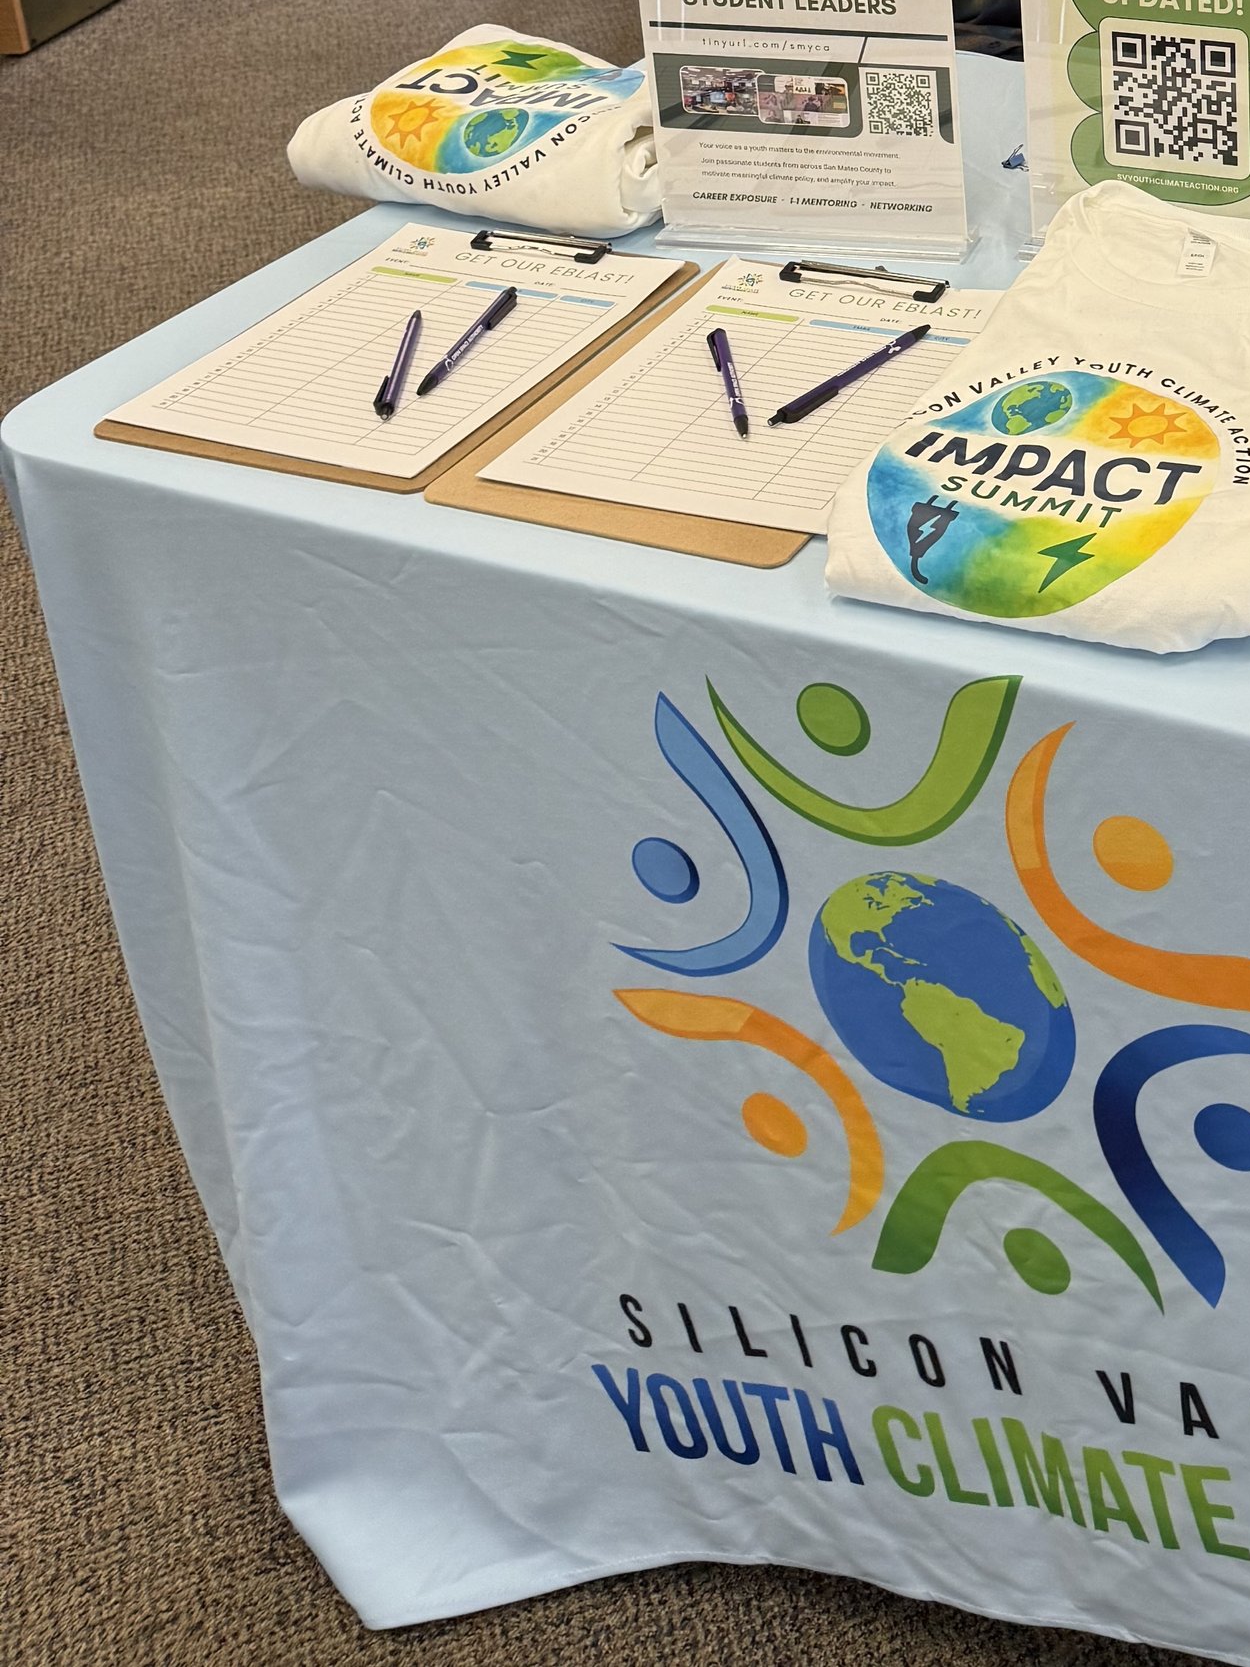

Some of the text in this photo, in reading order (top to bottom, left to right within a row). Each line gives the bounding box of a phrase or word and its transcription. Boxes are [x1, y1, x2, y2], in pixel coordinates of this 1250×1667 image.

[702, 38, 830, 52] tinyurl.com/smyca
[396, 69, 608, 109] IMPACT
[355, 129, 546, 194] VALLEY YOUTH CLIMATE
[716, 158, 752, 168] passionate
[837, 165, 858, 173] Mateo
[860, 166, 883, 175] County
[749, 145, 767, 153] youth
[768, 146, 794, 154] matters
[816, 148, 863, 157] environmental
[1116, 173, 1239, 194] SVYOUTHCLIMATEACTION.ORG
[692, 191, 728, 201] CAREER
[730, 193, 777, 204] EXPOSURE
[801, 198, 857, 208] MENTORING
[870, 202, 933, 213] NETWORKING
[455, 253, 635, 284] GET OUR EBLAST!
[789, 289, 981, 319] GET OUR EBLAST!
[969, 356, 1060, 395] VALLEY
[1074, 356, 1153, 379] YOUTH
[1161, 378, 1236, 425] CLIMATE
[905, 432, 1202, 506] IMPACT
[941, 475, 1122, 528] SUMMIT
[618, 1292, 1024, 1396] SILICON
[591, 1361, 866, 1487] YOUTH
